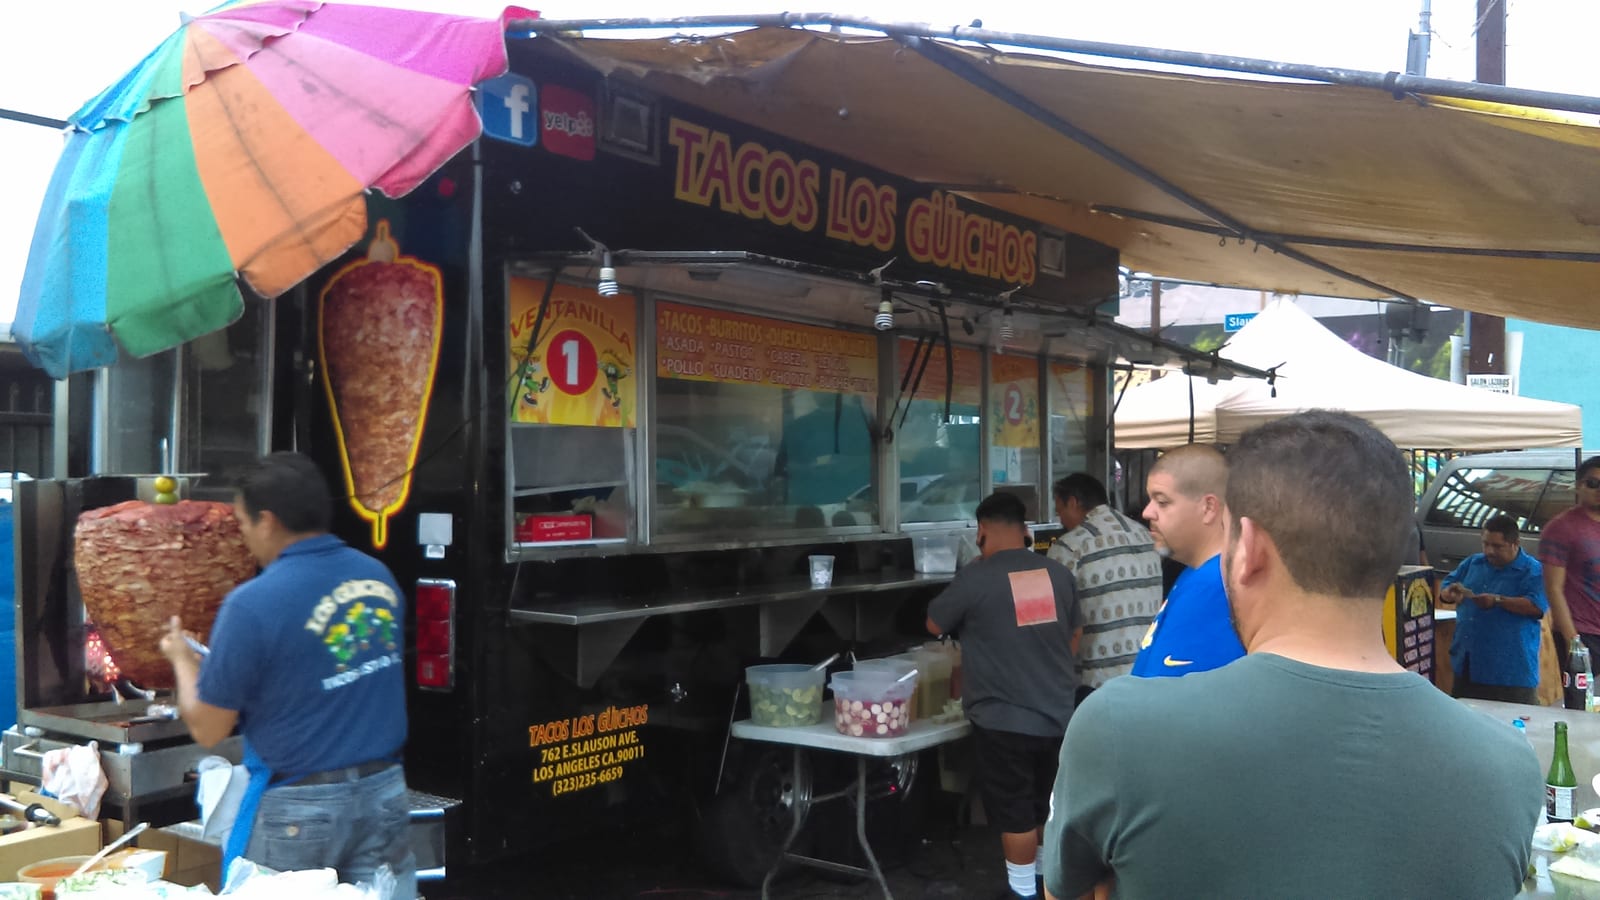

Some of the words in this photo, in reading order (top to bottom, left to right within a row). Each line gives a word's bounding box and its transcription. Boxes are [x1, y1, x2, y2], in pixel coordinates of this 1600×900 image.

[544, 111, 577, 136] yelp
[669, 116, 819, 231] TACOS
[826, 168, 897, 251] LOS
[905, 189, 1037, 286] GÜICHOS
[510, 300, 632, 355] VENTANILLA
[562, 340, 579, 386] 1
[1008, 390, 1022, 420] 2
[529, 719, 569, 747] TACOS
[572, 714, 595, 738] LOS
[541, 746, 560, 763] 762
[562, 735, 617, 758] E.SLAUSON
[618, 730, 639, 746] AVE.
[533, 765, 554, 782] LOS
[555, 754, 600, 777] ANGELES
[602, 745, 644, 766] CA.90011
[552, 766, 623, 796] (323)235-6659
